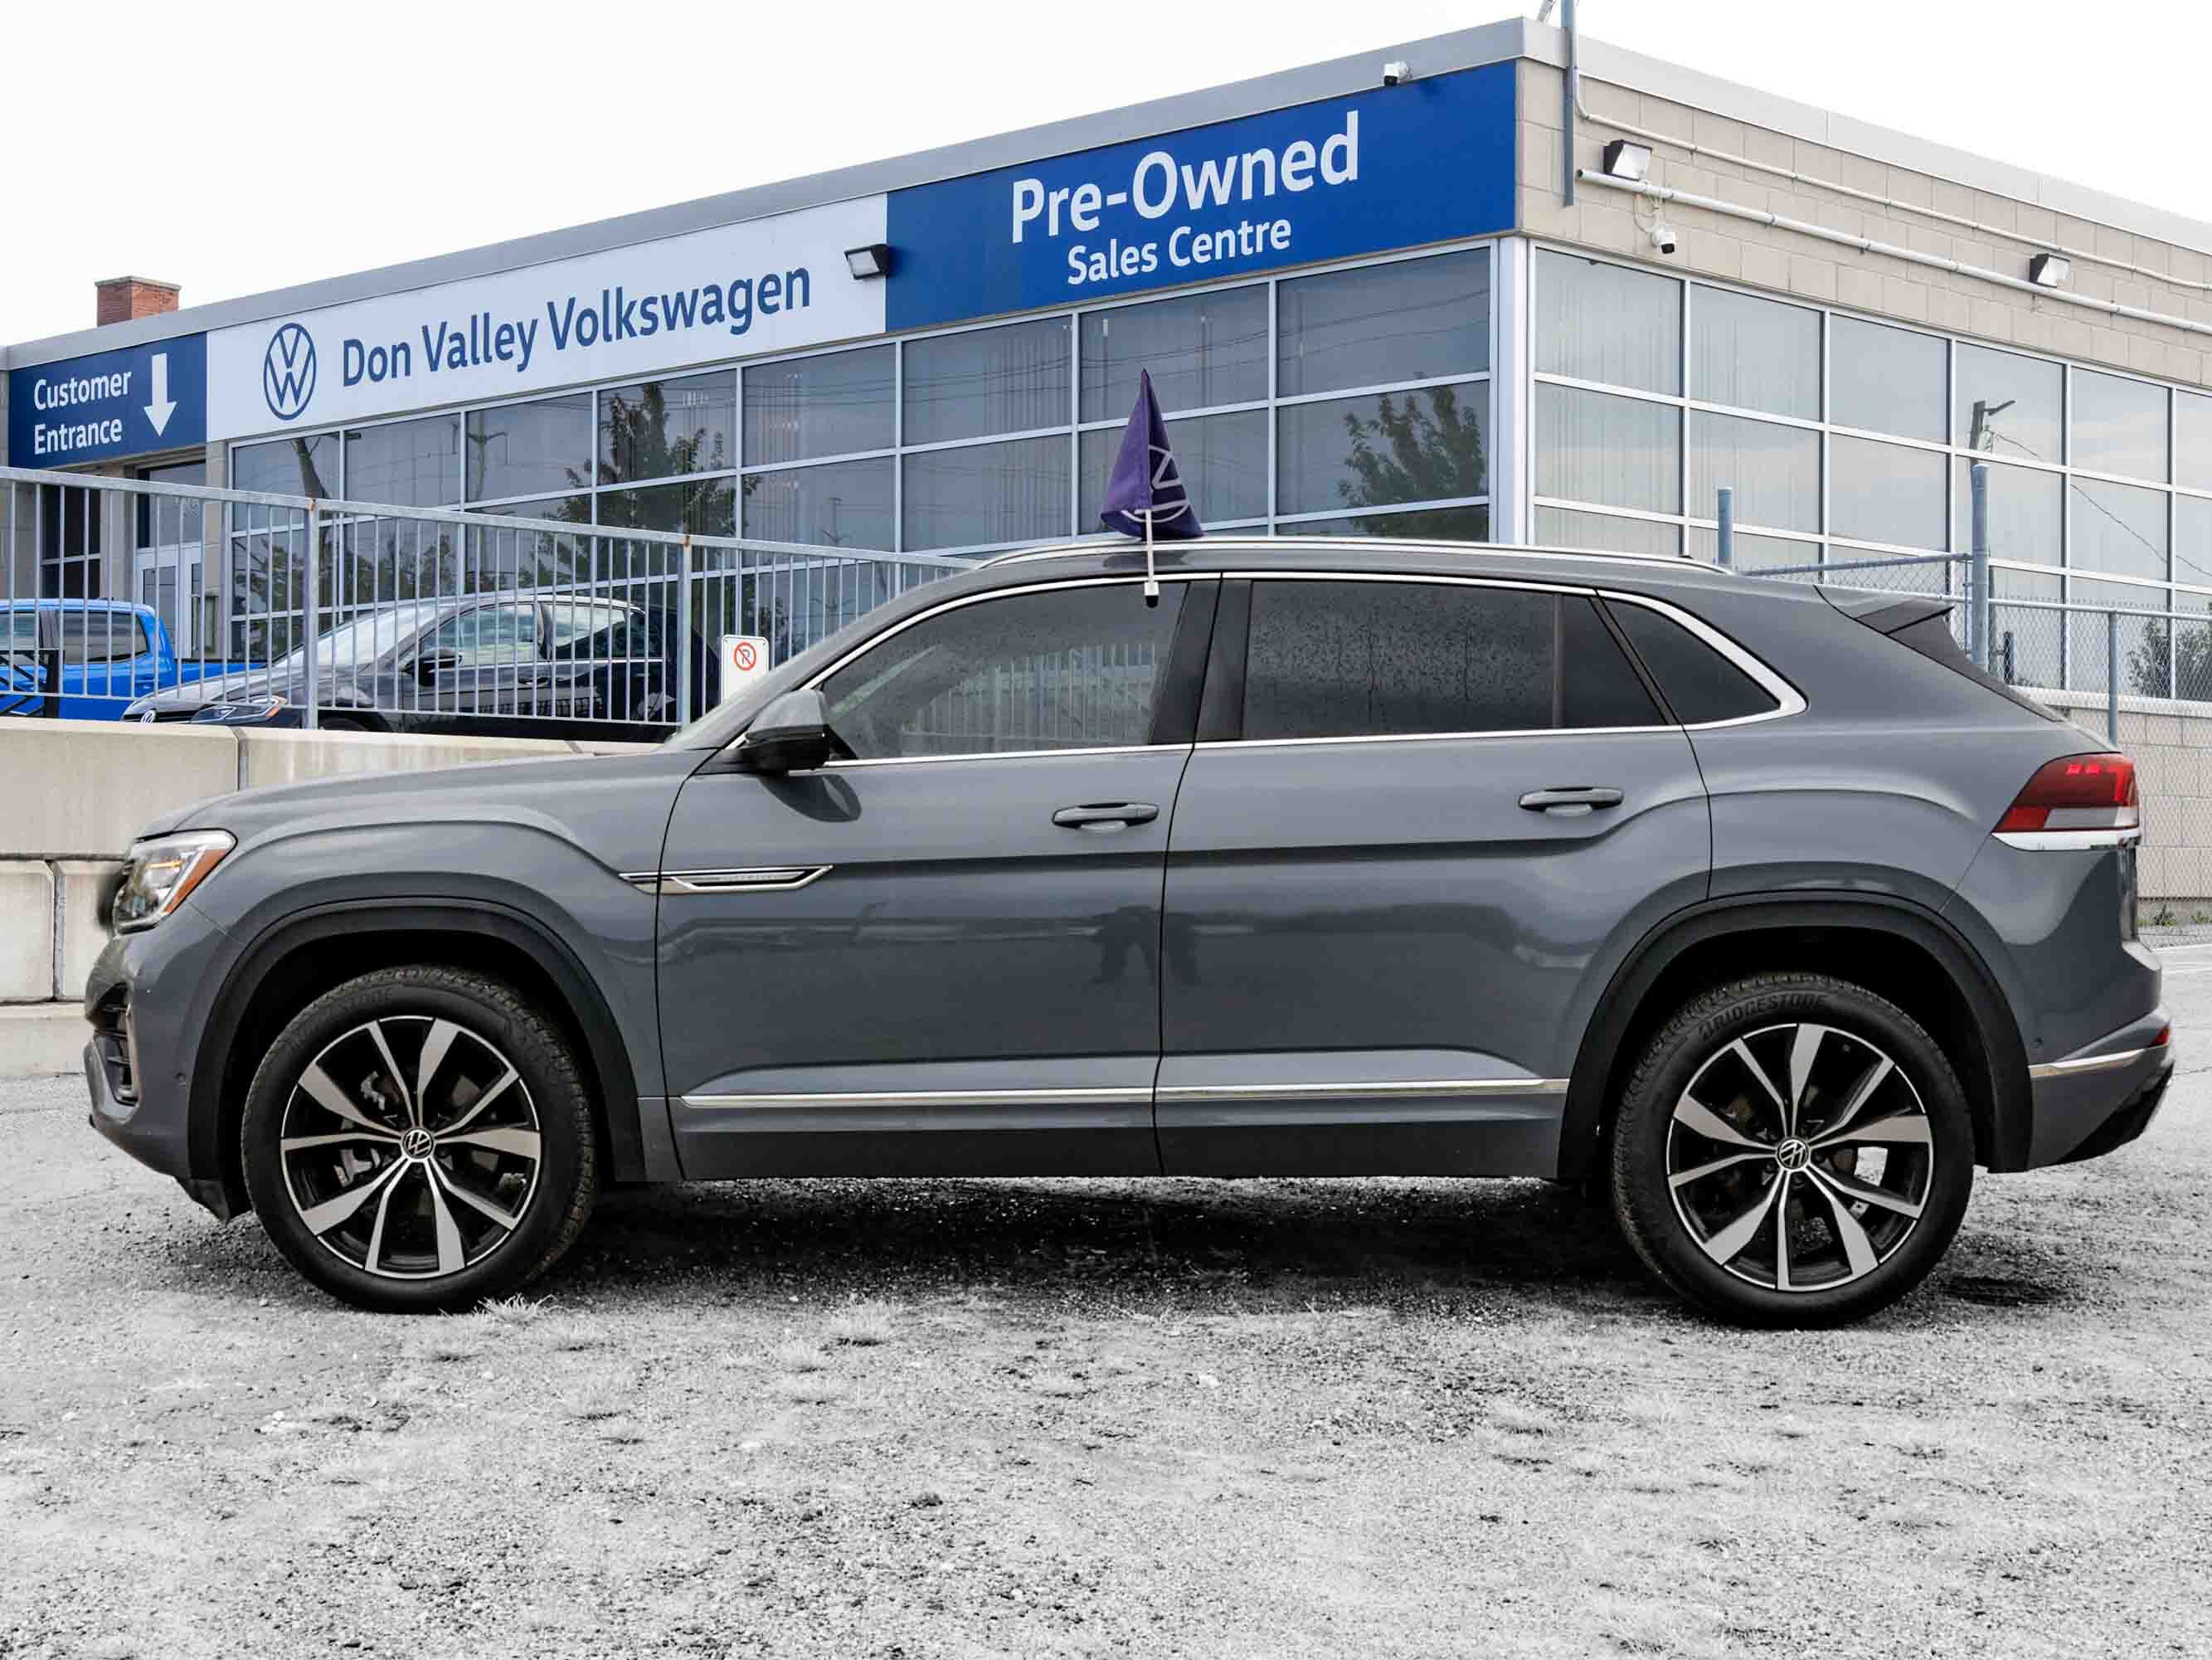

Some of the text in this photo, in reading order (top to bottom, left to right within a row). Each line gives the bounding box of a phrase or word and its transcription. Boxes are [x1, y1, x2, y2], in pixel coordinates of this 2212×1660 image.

[1012, 110, 1359, 245] Pre-Owned
[1067, 219, 1292, 286] Sales Centre
[343, 266, 811, 388] Don Valley Volkswagen
[34, 371, 132, 411] Customer
[263, 322, 317, 421] VW
[34, 418, 123, 455] Entrance
